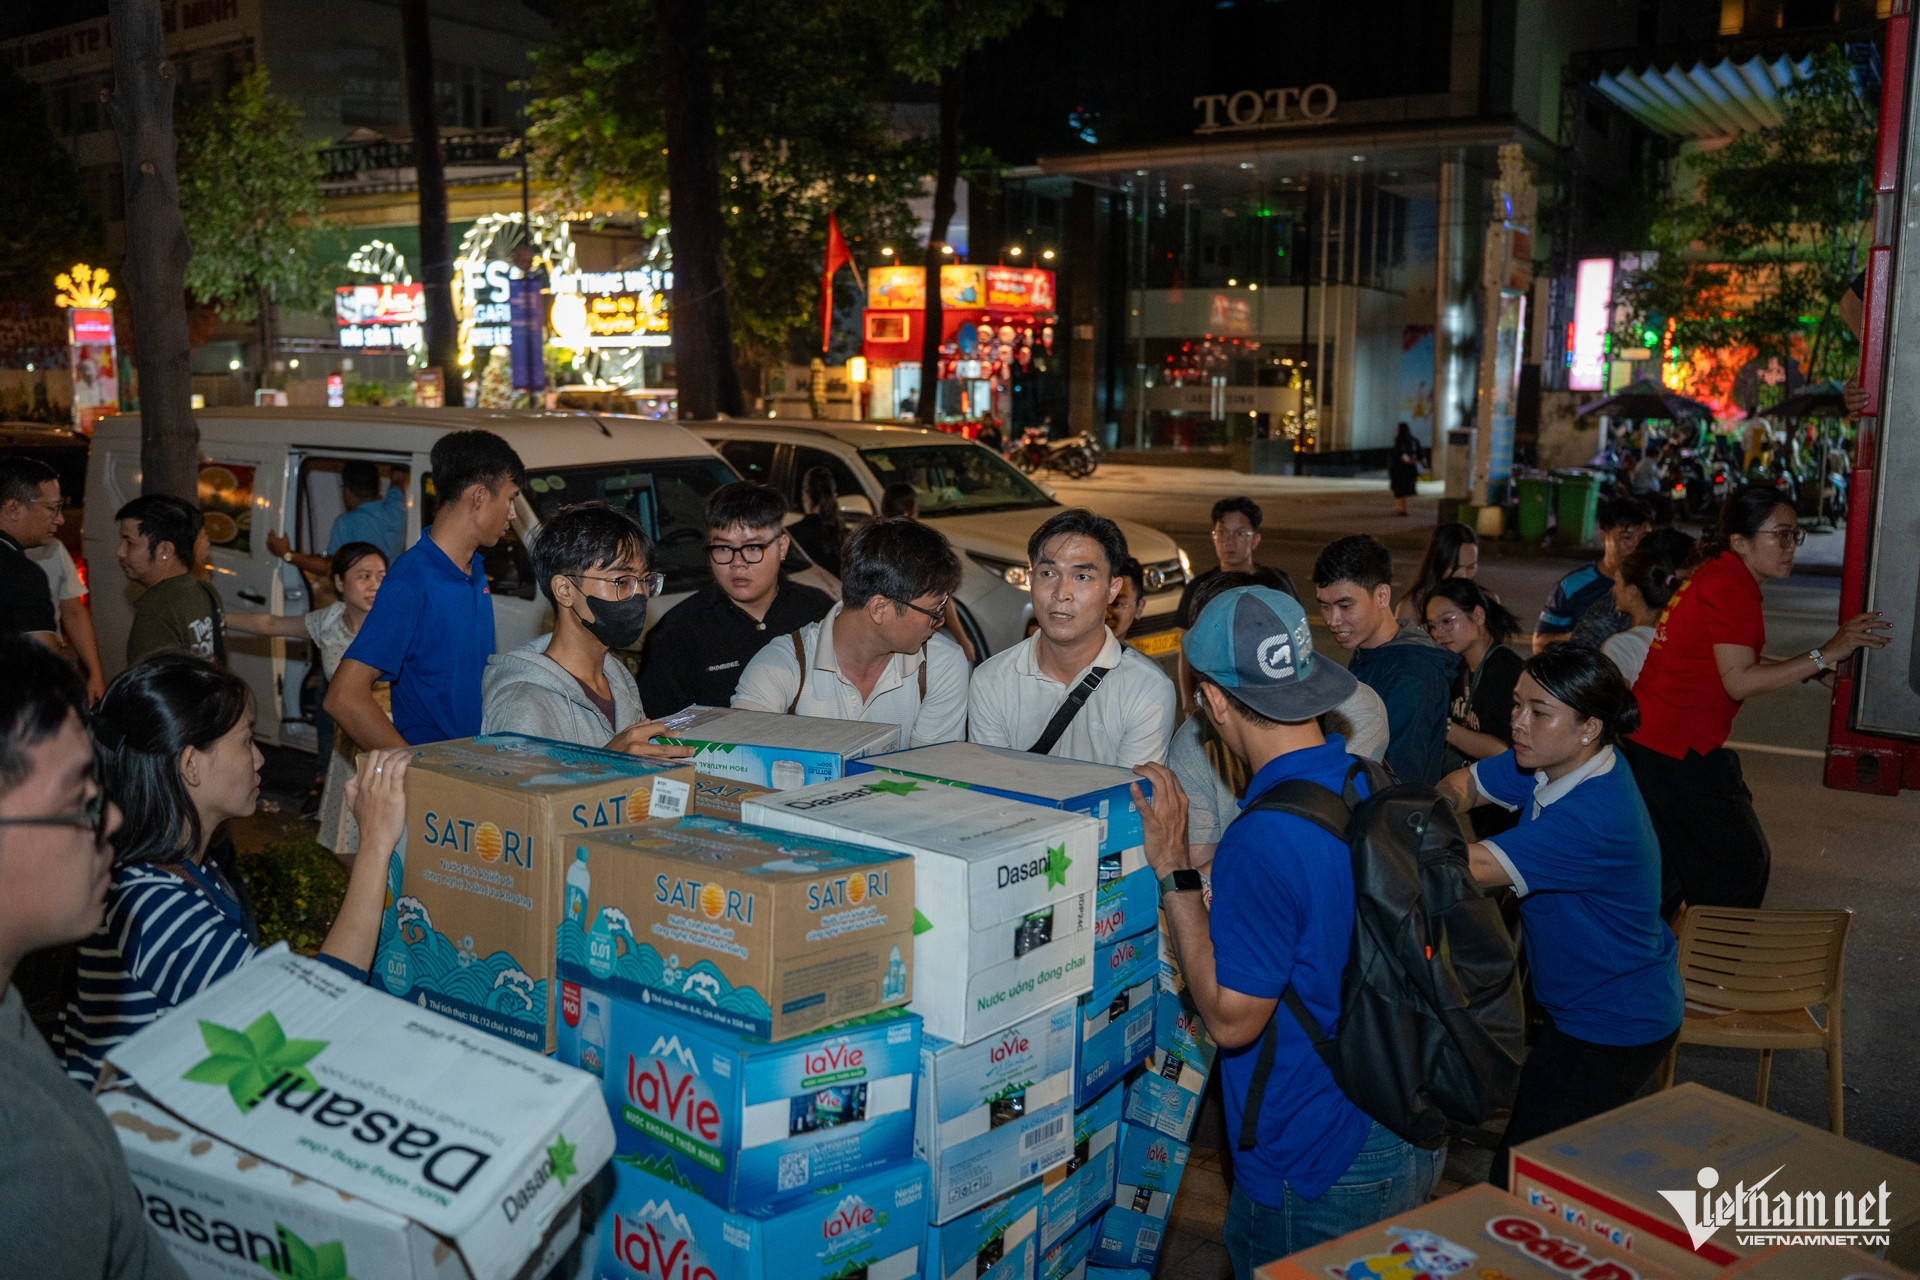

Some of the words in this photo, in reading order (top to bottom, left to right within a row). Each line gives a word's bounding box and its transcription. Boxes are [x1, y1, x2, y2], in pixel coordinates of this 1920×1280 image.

[1193, 83, 1338, 129] TOTO
[699, 762, 729, 771] NATURAL
[729, 765, 749, 773] FROM
[424, 811, 533, 869] SATORI
[997, 849, 1051, 889] Dasani
[655, 873, 753, 924] SATORI
[807, 870, 889, 912] SATORI
[589, 941, 612, 960] 0.01
[1064, 955, 1087, 973] chai
[1109, 944, 1135, 970] laVie
[387, 959, 408, 978] 0.01
[480, 1016, 491, 1028] (12
[491, 1019, 505, 1032] chai
[509, 1026, 526, 1039] 1500
[526, 1029, 538, 1043] ml)
[804, 1044, 864, 1075] laVie
[990, 1036, 1030, 1064] laVie
[628, 1052, 721, 1140] laVie
[246, 1070, 491, 1193] Dasani
[1147, 1145, 1168, 1163] laVie
[135, 1186, 292, 1275] asani
[823, 1205, 874, 1240] laVie
[1490, 1217, 1590, 1271] Gấu
